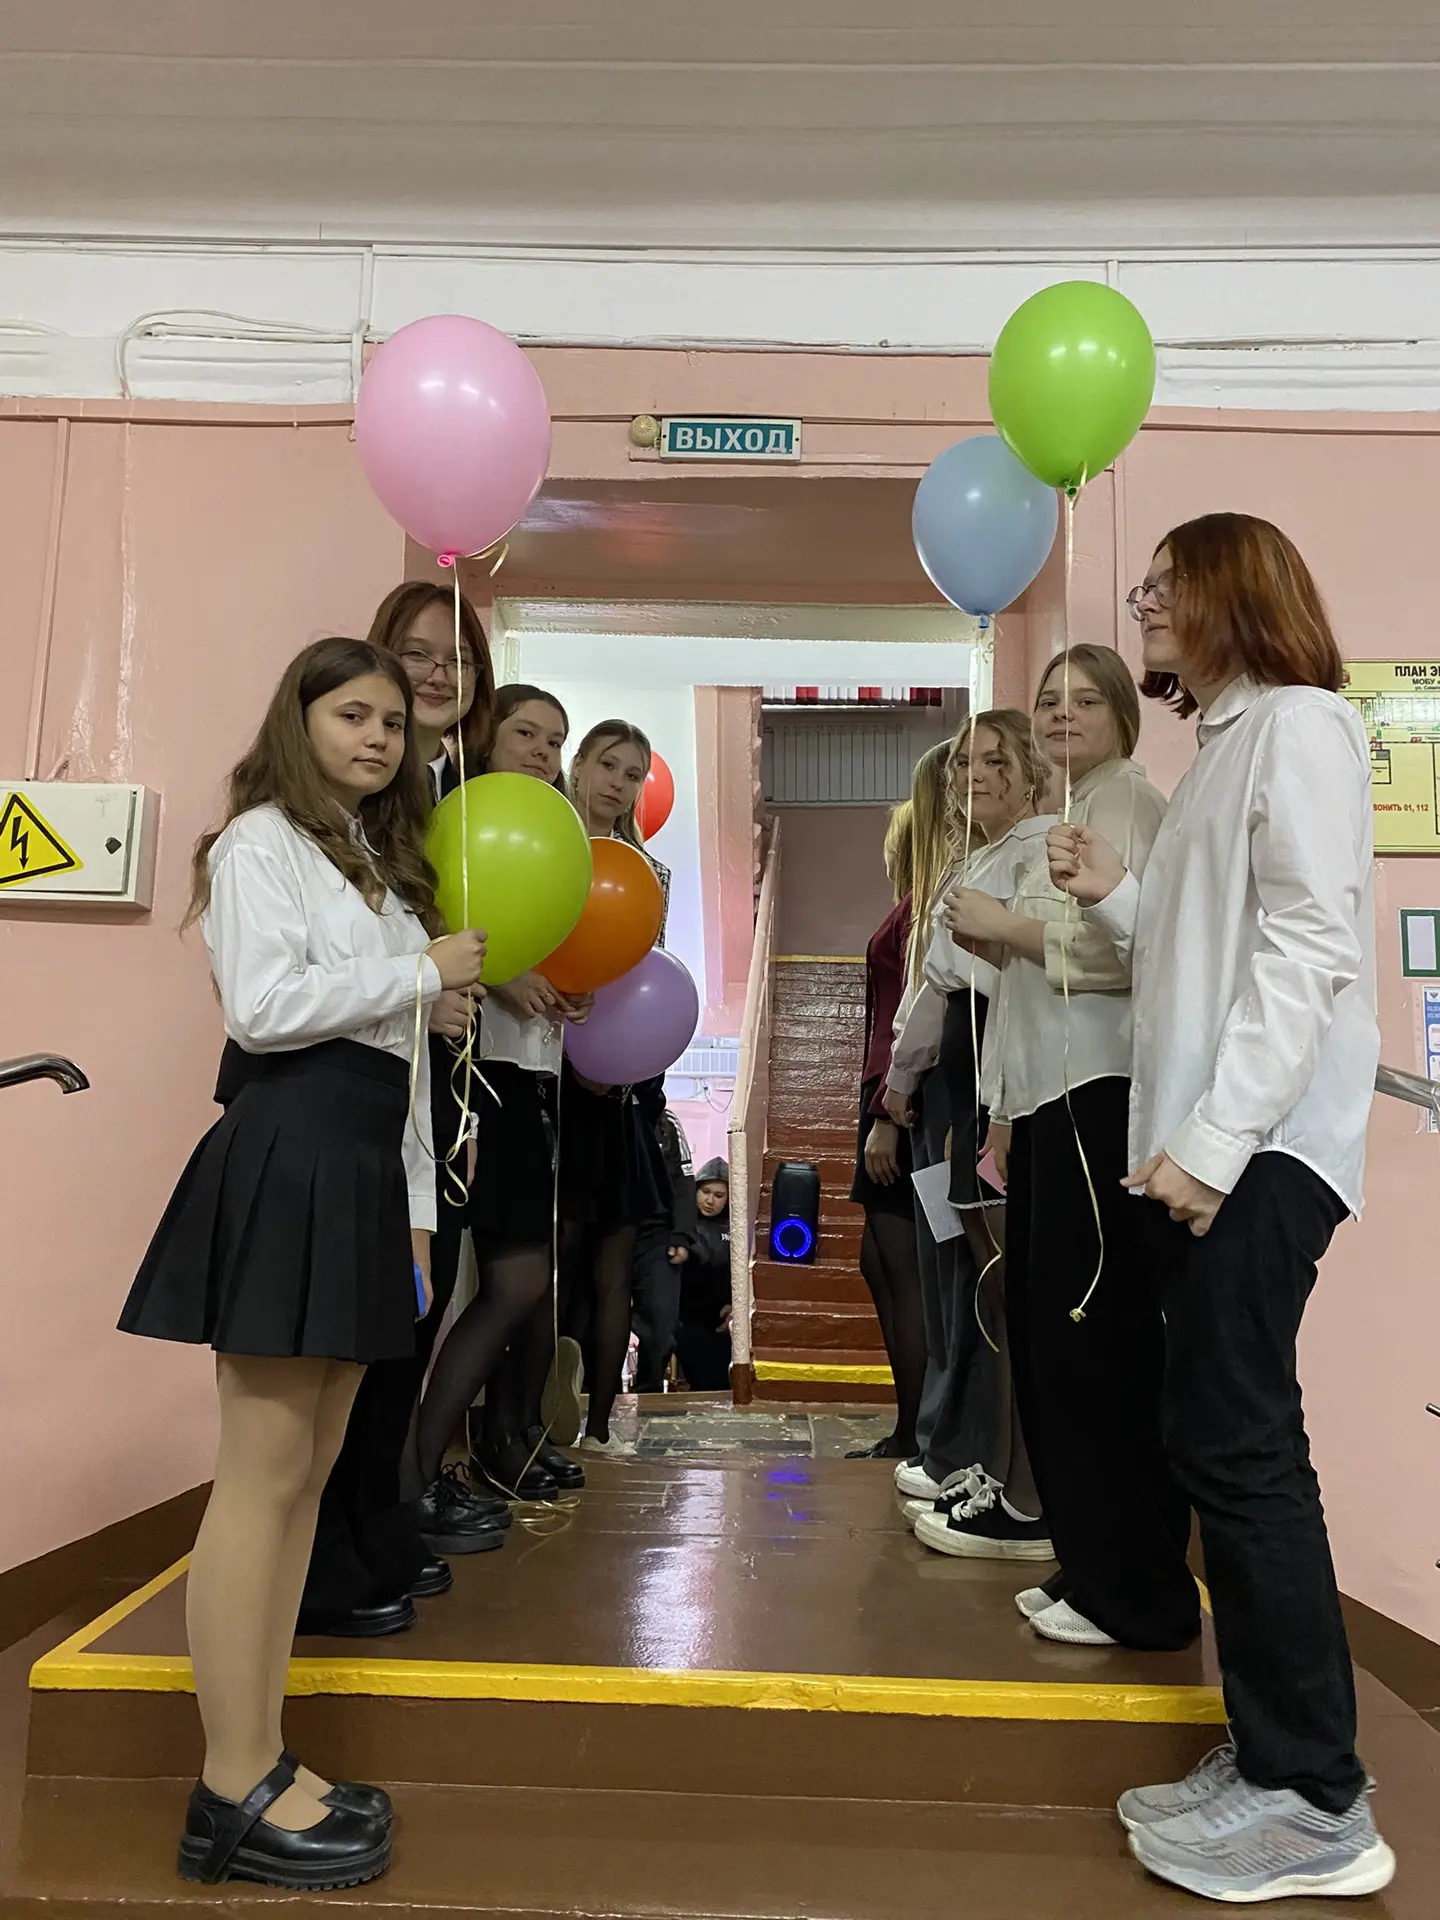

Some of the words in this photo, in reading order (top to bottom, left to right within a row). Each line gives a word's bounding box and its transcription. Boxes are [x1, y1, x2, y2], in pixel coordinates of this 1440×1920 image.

[676, 427, 787, 454] ВЫХОД
[1395, 666, 1427, 677] ПЛАН
[1430, 666, 1440, 677] Э
[1373, 803, 1402, 811] ВОНИТЬ
